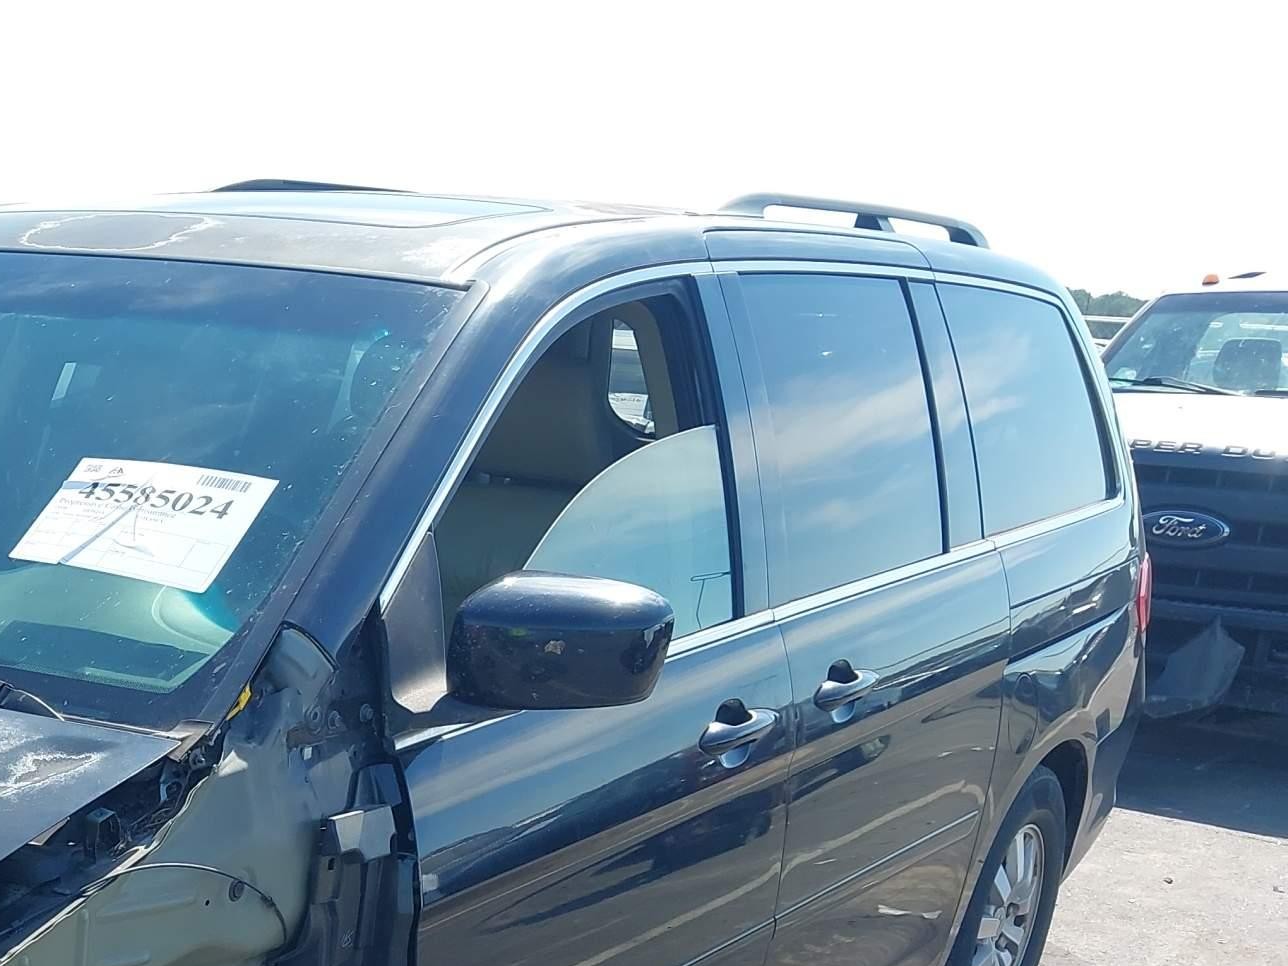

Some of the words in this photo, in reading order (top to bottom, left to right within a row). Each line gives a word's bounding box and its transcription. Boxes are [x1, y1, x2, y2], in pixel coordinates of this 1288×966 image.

[1128, 438, 1204, 455] PER
[1221, 445, 1288, 462] DU
[78, 481, 235, 519] 45585024
[1152, 515, 1208, 538] Ford
